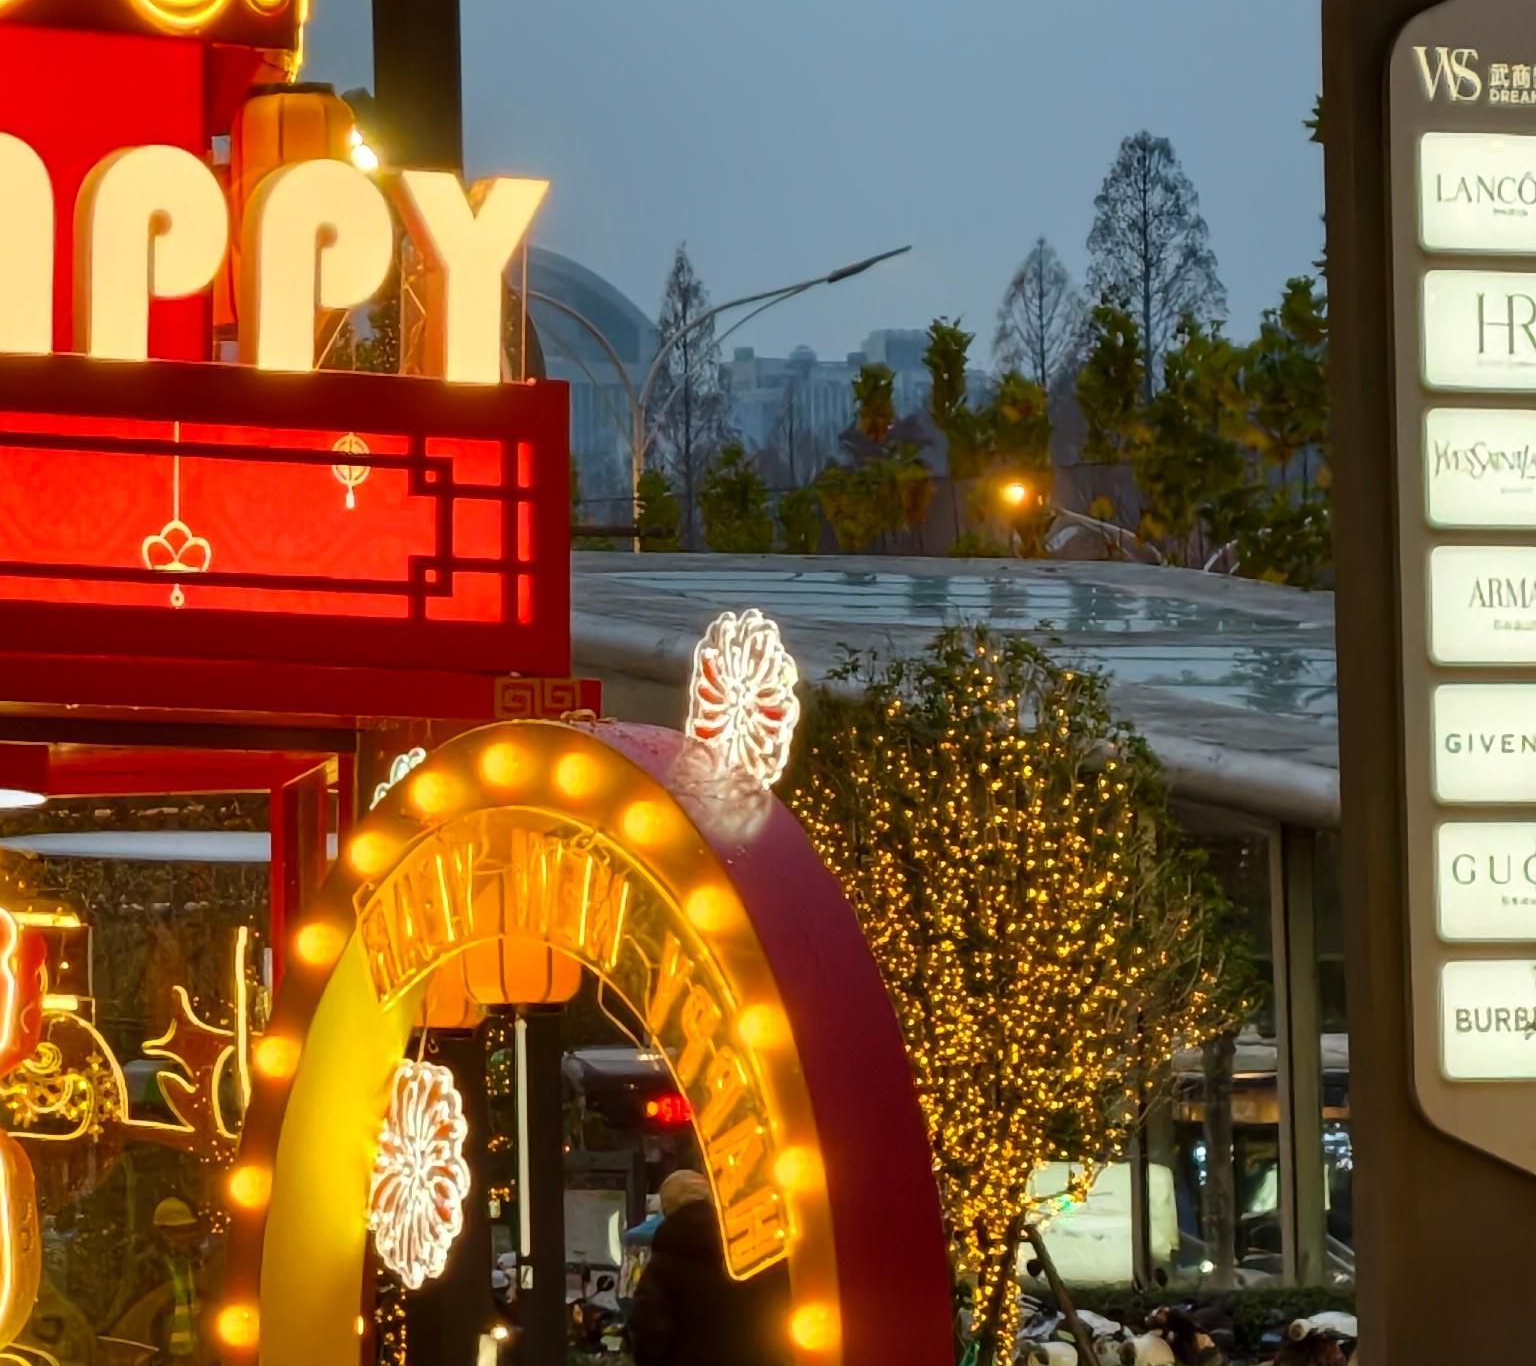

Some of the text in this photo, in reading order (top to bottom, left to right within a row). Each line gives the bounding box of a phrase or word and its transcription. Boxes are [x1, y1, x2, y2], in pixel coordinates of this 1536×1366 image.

[1489, 64, 1536, 89] 武商
[1476, 292, 1536, 356] HR
[1456, 1006, 1536, 1033] BURB
